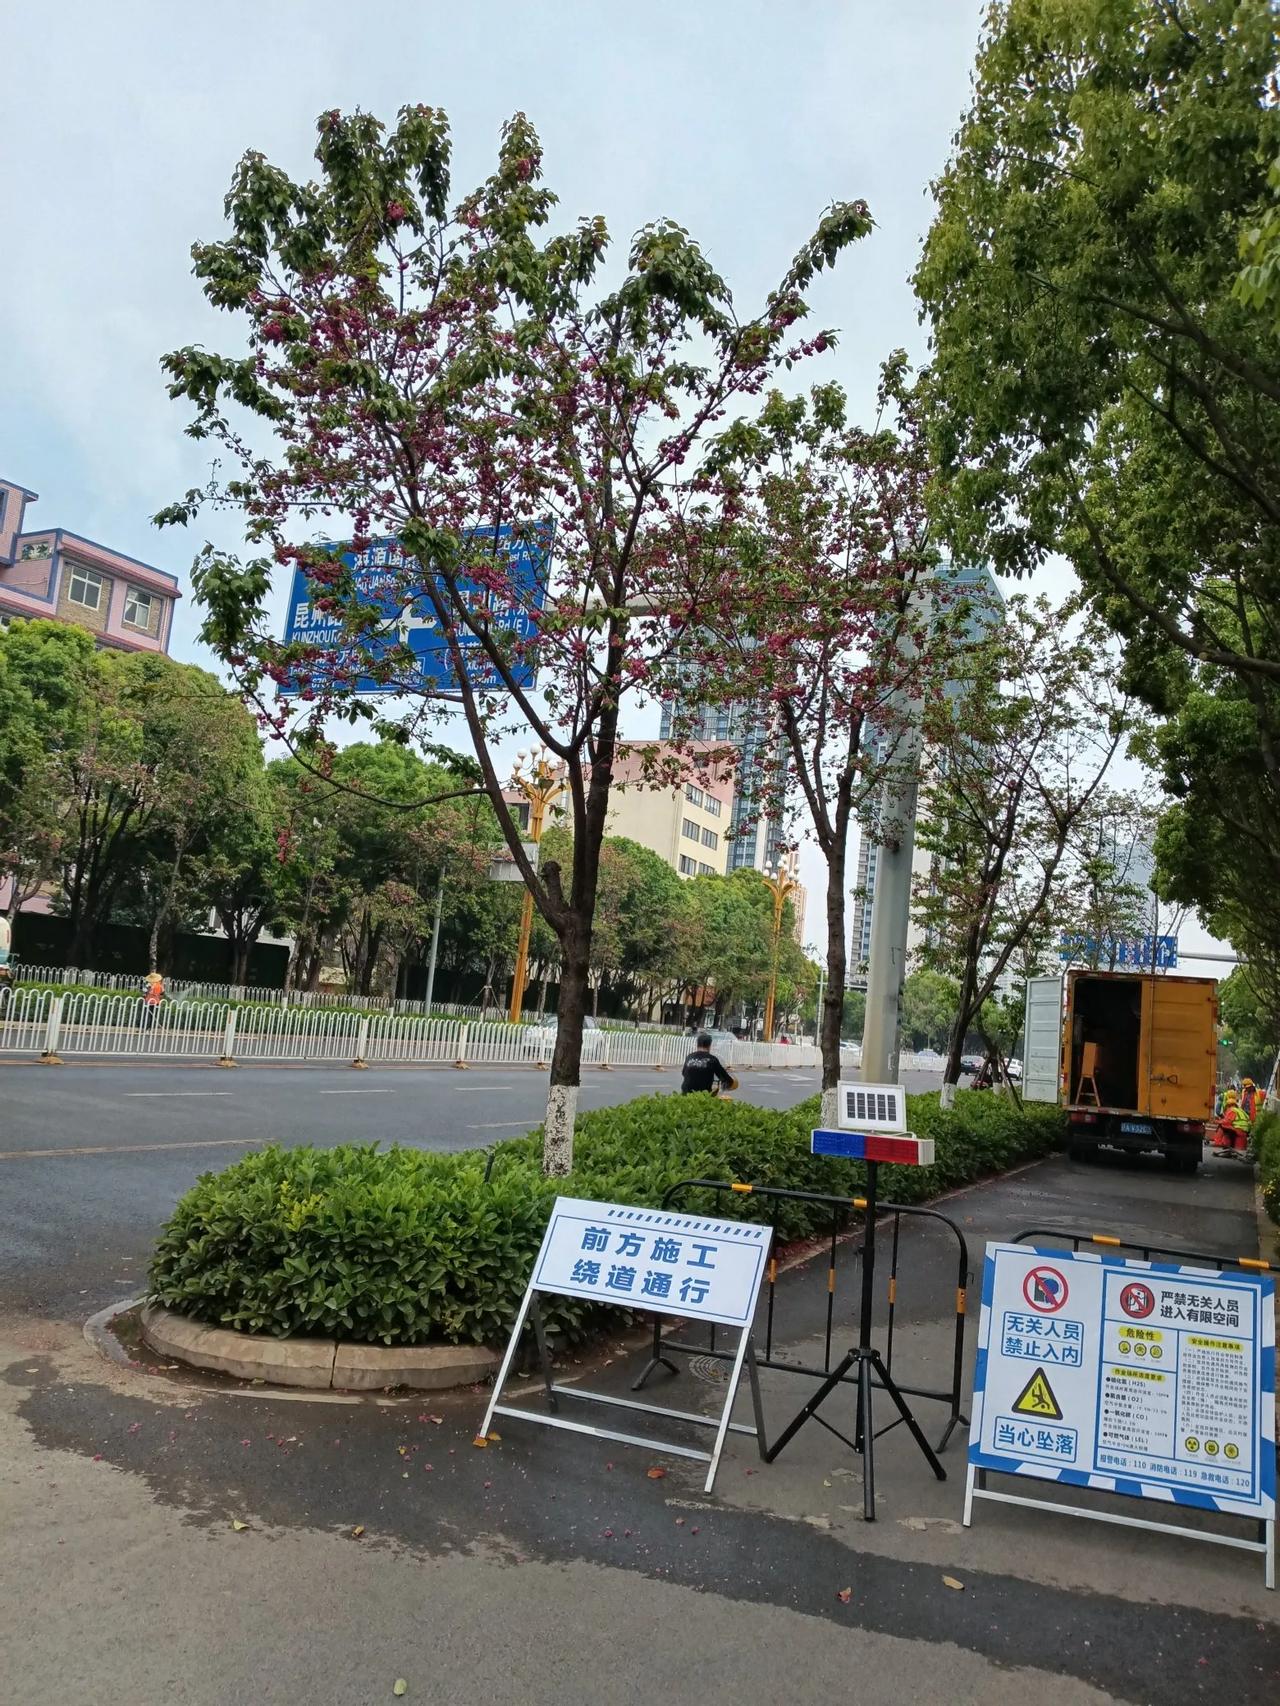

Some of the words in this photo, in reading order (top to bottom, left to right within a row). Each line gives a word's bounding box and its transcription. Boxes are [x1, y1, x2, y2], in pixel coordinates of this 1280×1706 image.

[581, 1226, 718, 1269] 前方施工
[570, 1259, 711, 1304] 绕道通行
[1160, 1290, 1240, 1313] 严禁无关人员
[1007, 1315, 1081, 1341] 无关人员
[1160, 1305, 1240, 1328] 进入有限空间
[1126, 1327, 1155, 1341] 危险性
[1005, 1336, 1080, 1364] 禁止入内
[998, 1426, 1075, 1455] 当心坠落
